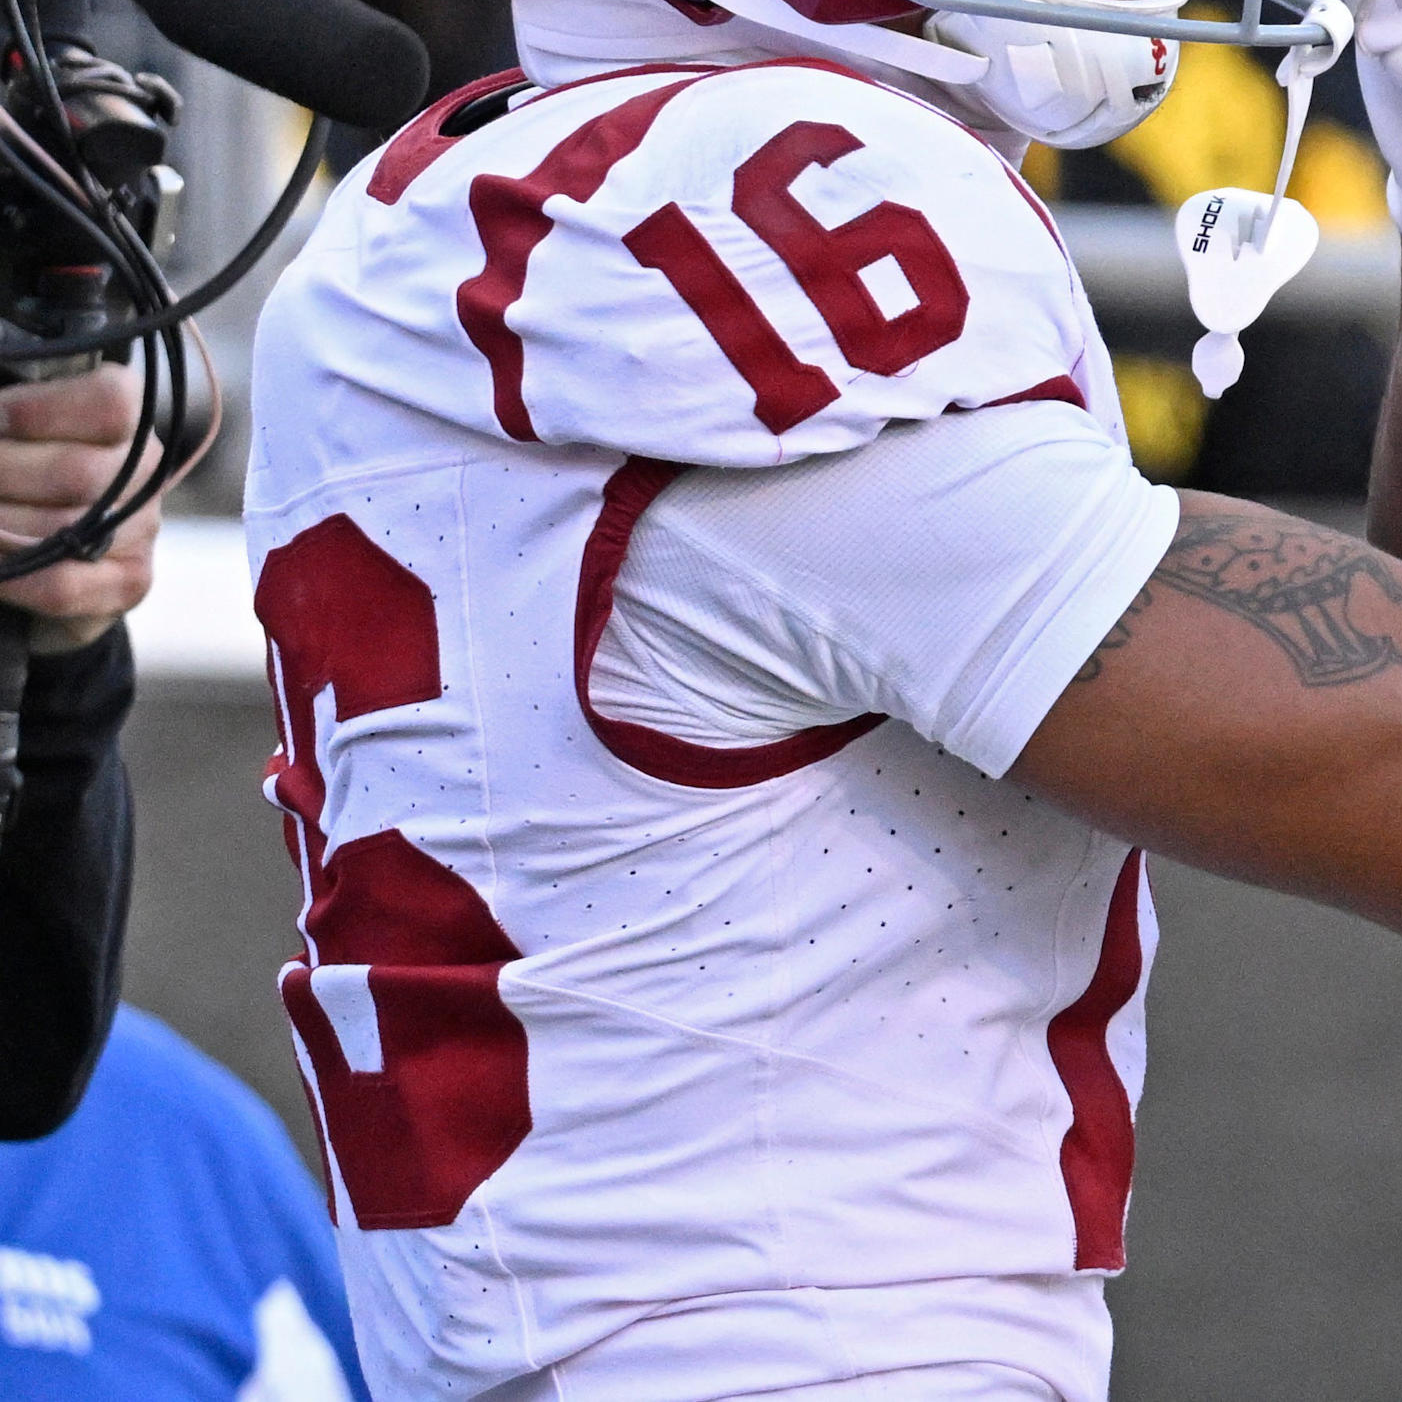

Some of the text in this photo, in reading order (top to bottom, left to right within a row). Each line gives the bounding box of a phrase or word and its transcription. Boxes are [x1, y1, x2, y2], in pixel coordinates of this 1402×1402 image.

[621, 120, 971, 436] 16
[1192, 195, 1226, 254] SHOCK
[254, 512, 533, 1230] 6
